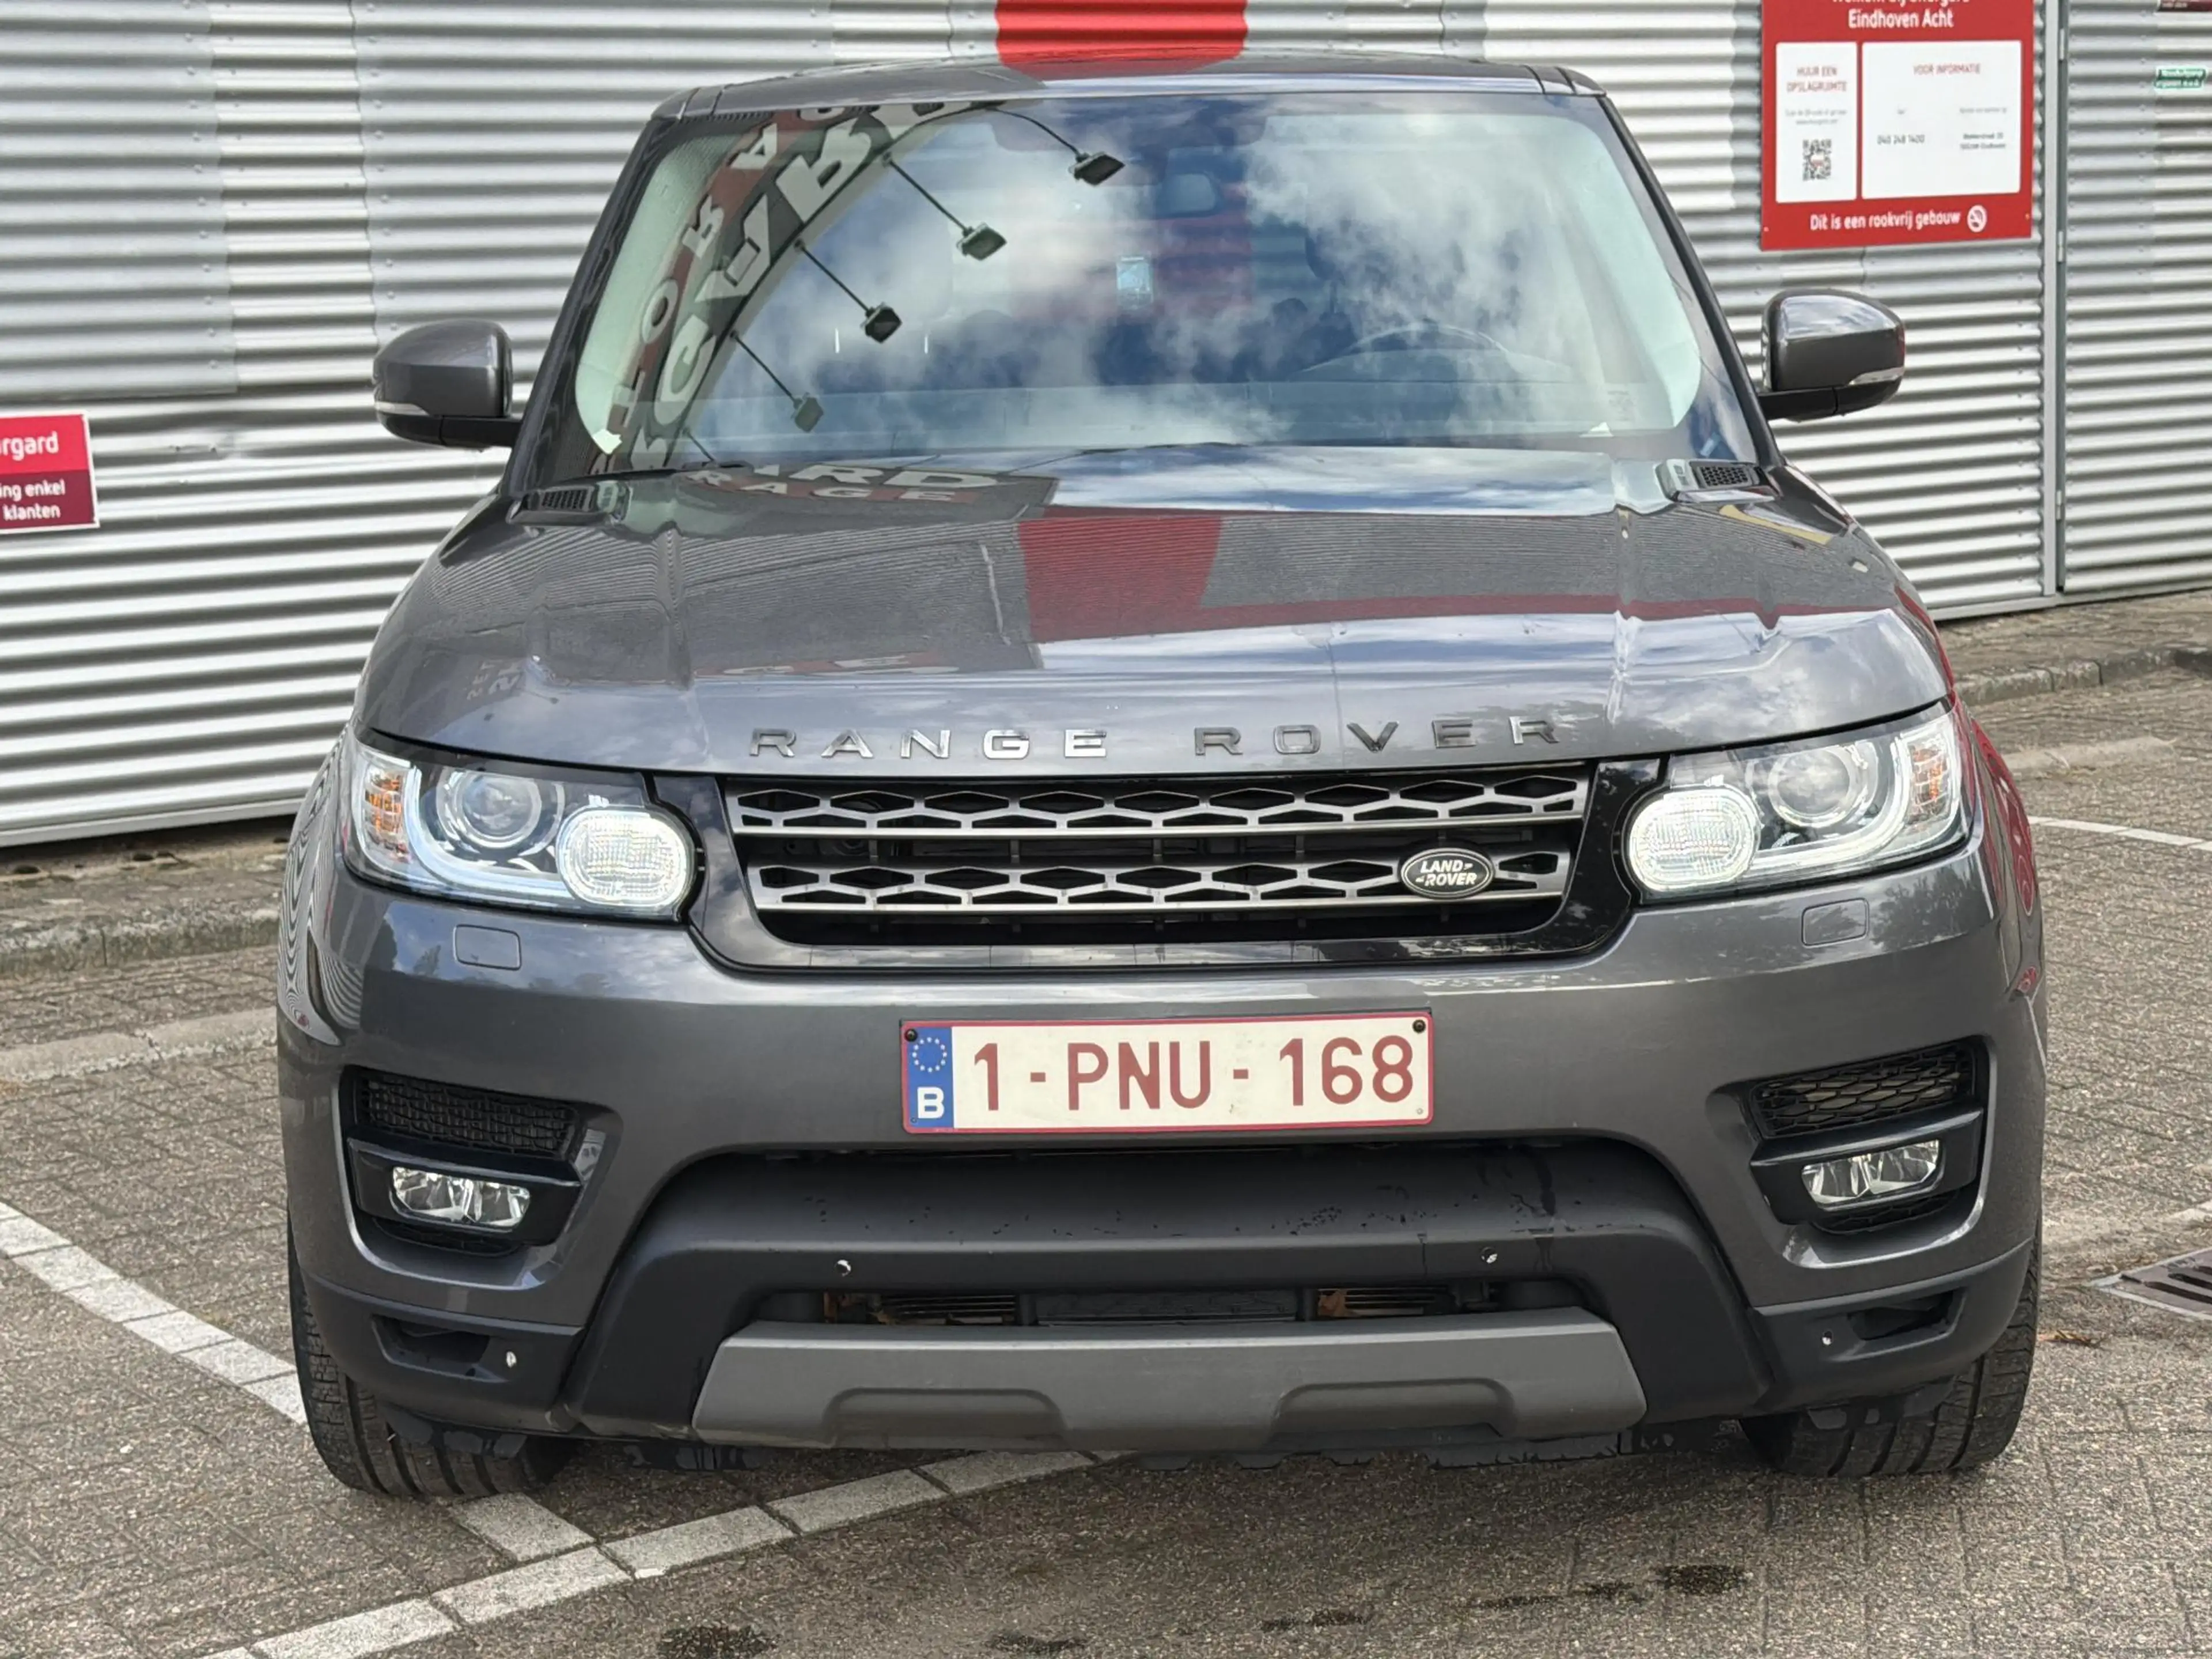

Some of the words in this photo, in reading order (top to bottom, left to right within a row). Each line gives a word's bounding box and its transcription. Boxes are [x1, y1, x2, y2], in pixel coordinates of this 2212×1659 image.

[1848, 9, 1919, 28] Eindhoven
[1922, 8, 1954, 28] Acht
[1913, 64, 1934, 75] VOOR
[1936, 63, 1980, 74] INFORMATIE
[1810, 213, 1828, 230] Dit
[1831, 213, 1842, 230] is
[1844, 214, 1866, 229] een
[1869, 210, 1913, 230] rookvrij
[1915, 210, 1961, 230] gebouw
[25, 478, 66, 498] enkel
[2, 502, 61, 521] klanten
[749, 728, 1107, 760] RANGE
[1194, 715, 1560, 756] ROVER
[1420, 859, 1463, 873] LAND
[1424, 872, 1478, 887] ROVER
[917, 1086, 945, 1120] B
